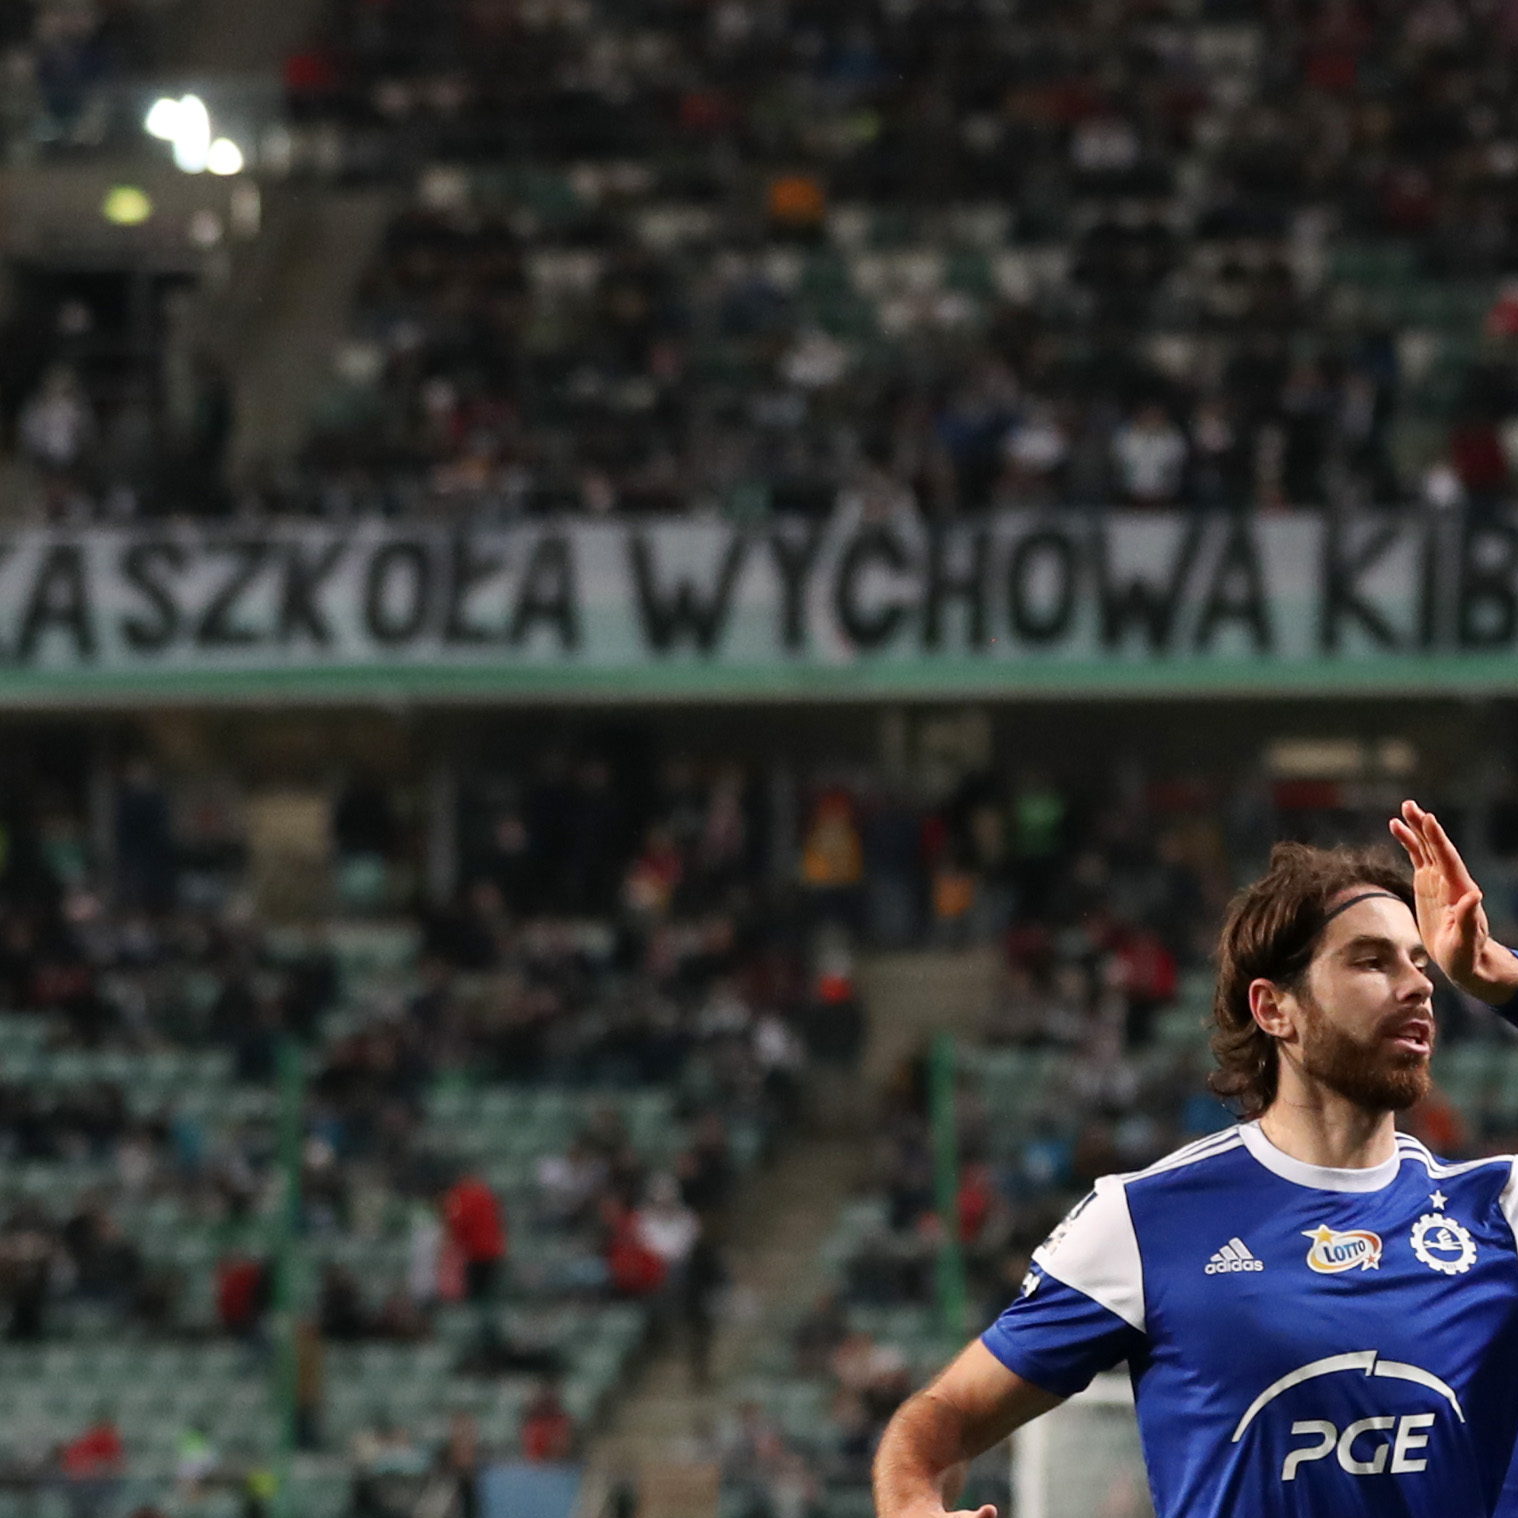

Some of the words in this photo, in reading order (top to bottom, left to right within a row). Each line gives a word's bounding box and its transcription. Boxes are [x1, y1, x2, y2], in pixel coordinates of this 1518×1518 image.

[630, 530, 1272, 655] WYCHOWA
[1205, 1259, 1264, 1275] adidas
[1323, 1240, 1366, 1263] LOTTO
[1281, 1413, 1435, 1481] PGE
